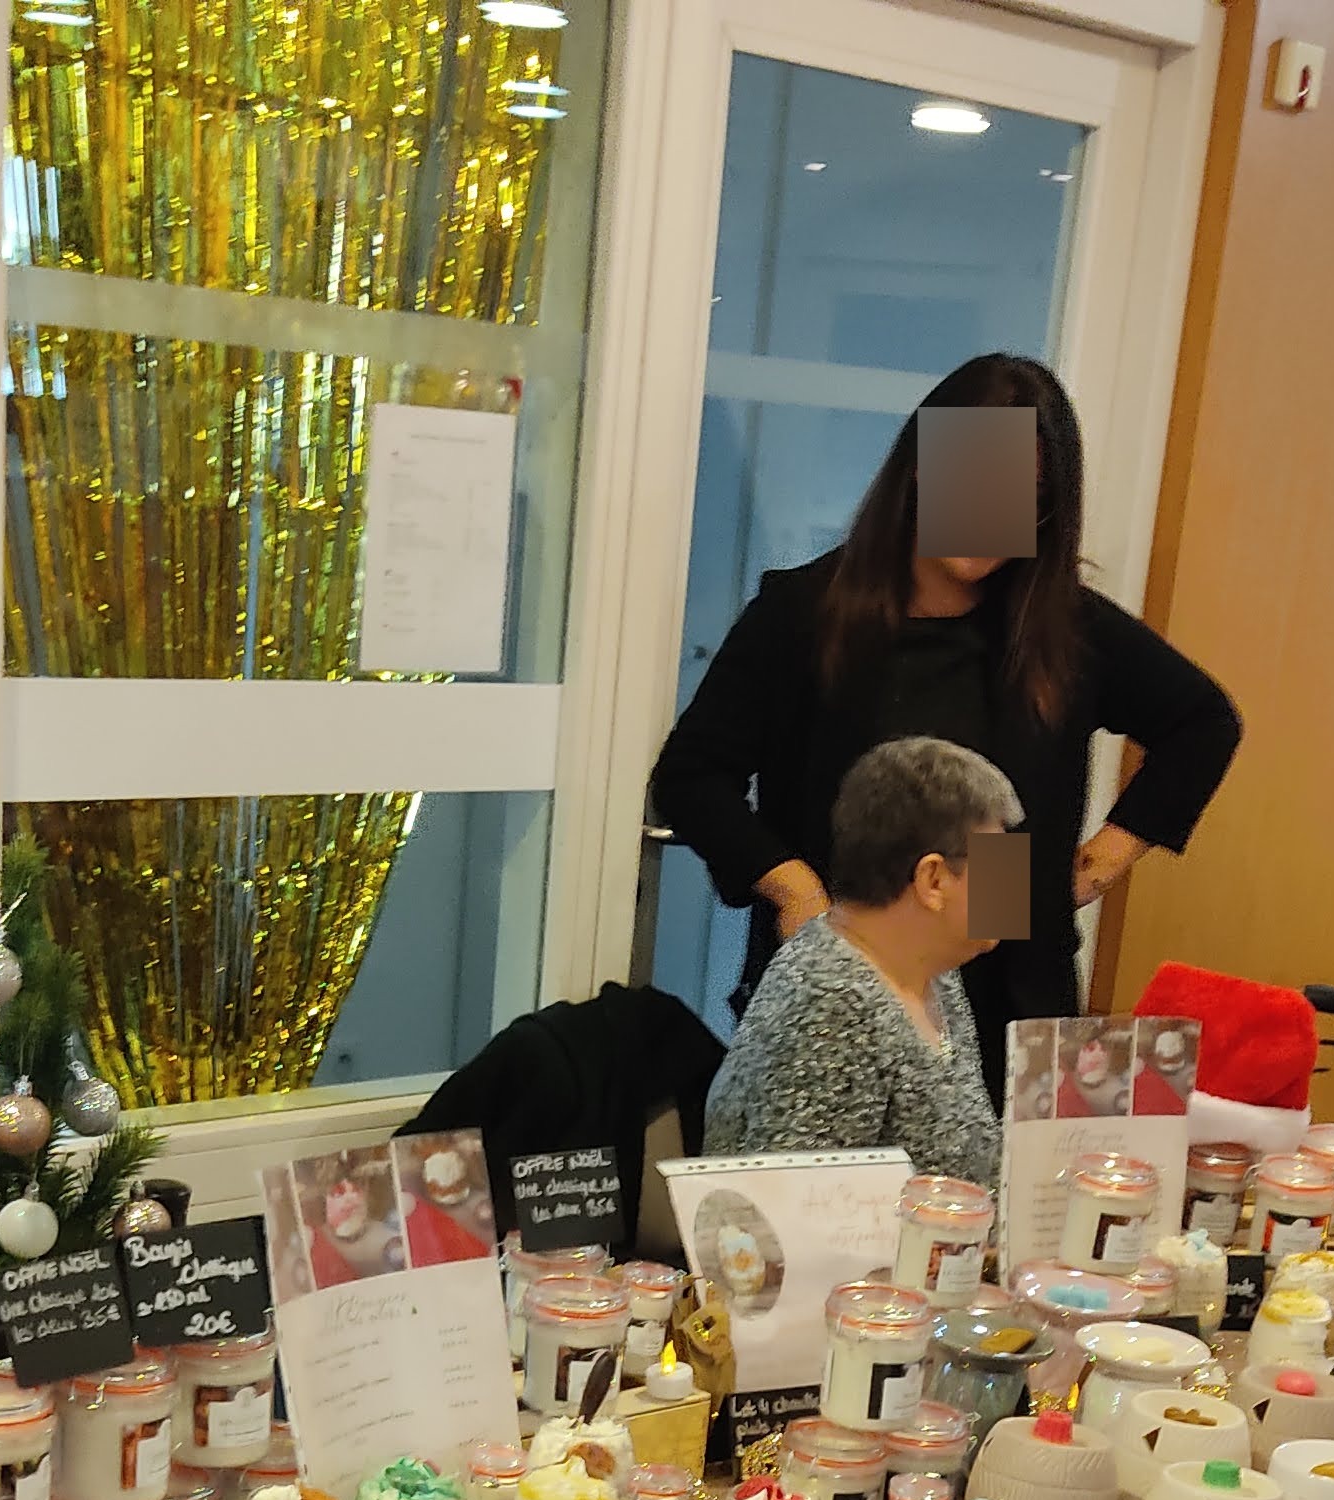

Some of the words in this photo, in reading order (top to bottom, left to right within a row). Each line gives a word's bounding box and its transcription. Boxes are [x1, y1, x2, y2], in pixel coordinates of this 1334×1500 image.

[512, 1154, 565, 1179] OFFRE
[2, 1260, 59, 1292] OFFRE
[58, 1248, 111, 1277] NOËL
[183, 1310, 237, 1337] 20€
